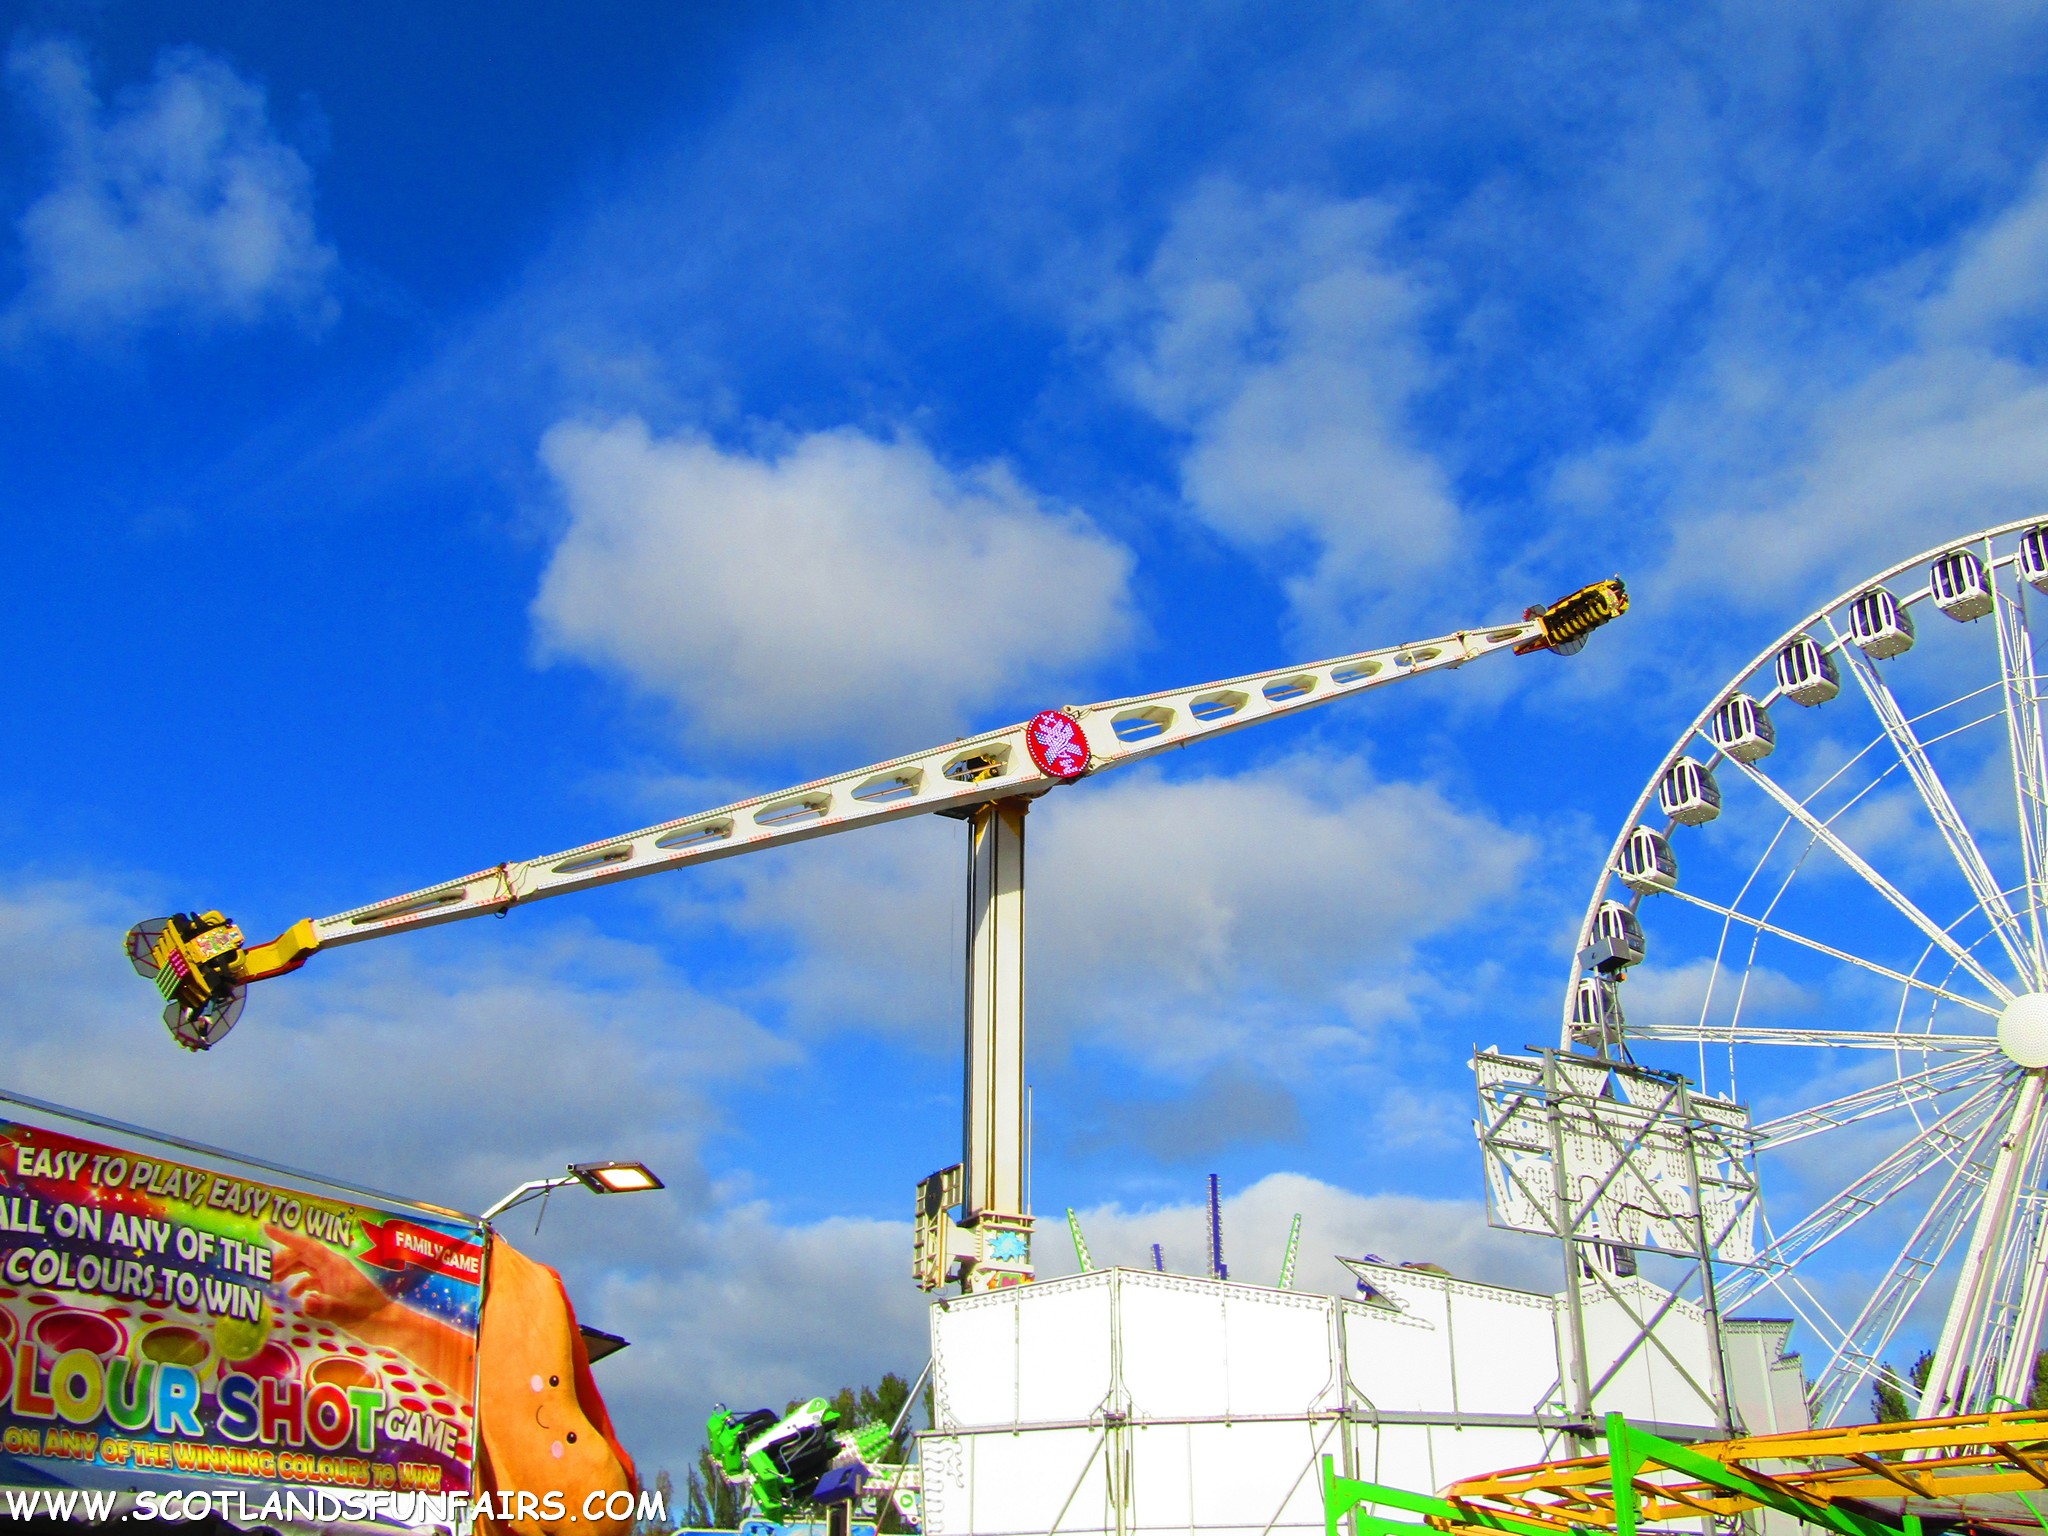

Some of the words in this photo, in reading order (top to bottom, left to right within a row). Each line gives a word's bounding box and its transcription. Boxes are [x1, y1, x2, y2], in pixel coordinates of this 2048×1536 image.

[17, 1146, 88, 1181] EASY
[91, 1154, 128, 1187] TO
[130, 1161, 204, 1207] PLAY,
[207, 1177, 271, 1218] EASY
[271, 1194, 301, 1229] TO
[305, 1206, 352, 1247] WIN
[54, 1203, 102, 1242] ON
[108, 1212, 171, 1254] ANY
[176, 1226, 215, 1264] OF
[220, 1236, 272, 1281] THE
[395, 1230, 444, 1260] FAMILY
[441, 1248, 479, 1274] GAME
[5, 1247, 155, 1299] COLOURS
[161, 1267, 199, 1306] TO
[204, 1277, 262, 1322] WIN
[0, 1337, 204, 1437] LOUR
[216, 1371, 387, 1453] SHOT
[384, 1408, 459, 1459] GAME
[4, 1426, 41, 1456] ON
[43, 1427, 98, 1461] ANY
[100, 1436, 132, 1465] OF
[131, 1437, 173, 1469] THE
[172, 1442, 277, 1480] WINNING
[277, 1450, 371, 1488] COLOURS
[371, 1462, 397, 1489] TO
[398, 1461, 442, 1493] WIN!
